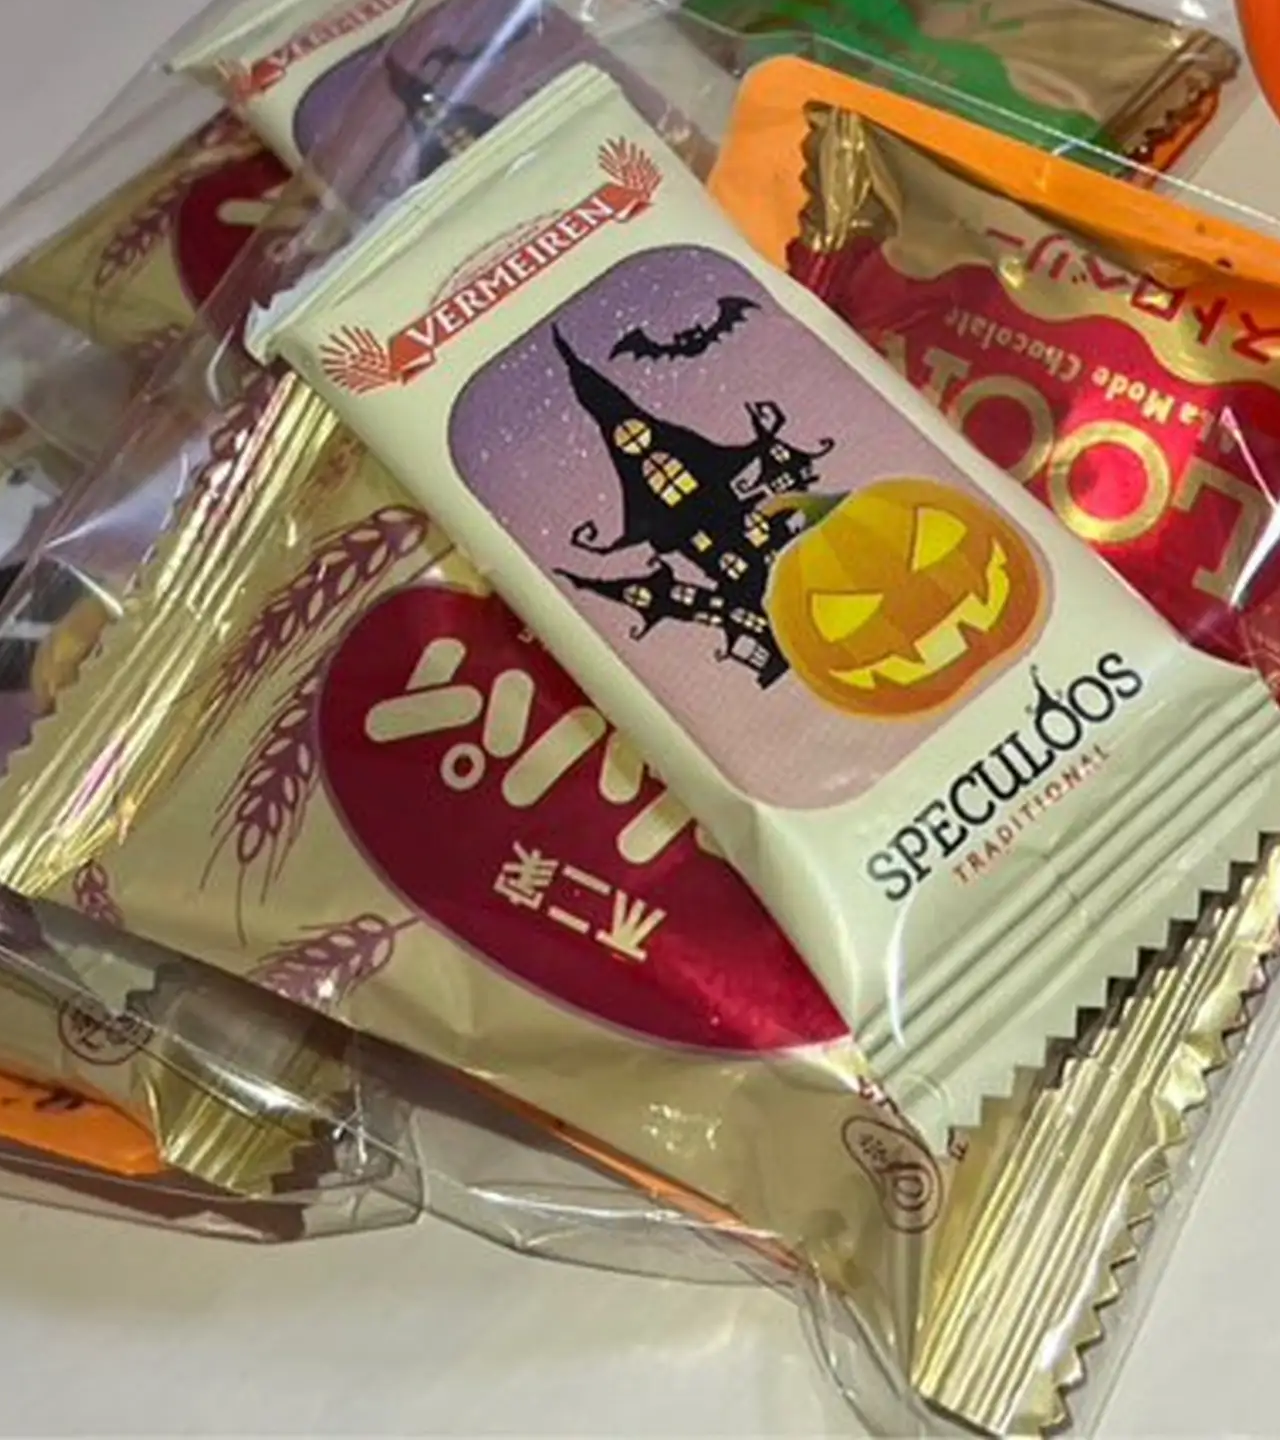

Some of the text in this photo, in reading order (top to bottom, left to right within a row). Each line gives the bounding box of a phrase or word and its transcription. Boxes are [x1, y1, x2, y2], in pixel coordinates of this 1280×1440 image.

[404, 195, 614, 350] VERMEIREN
[942, 305, 1083, 383] Chocolate
[1090, 364, 1176, 426] Mode
[866, 652, 1143, 901] SPECULOOS
[953, 742, 1111, 885] TRADITIONAL
[494, 840, 667, 962] 不二家
